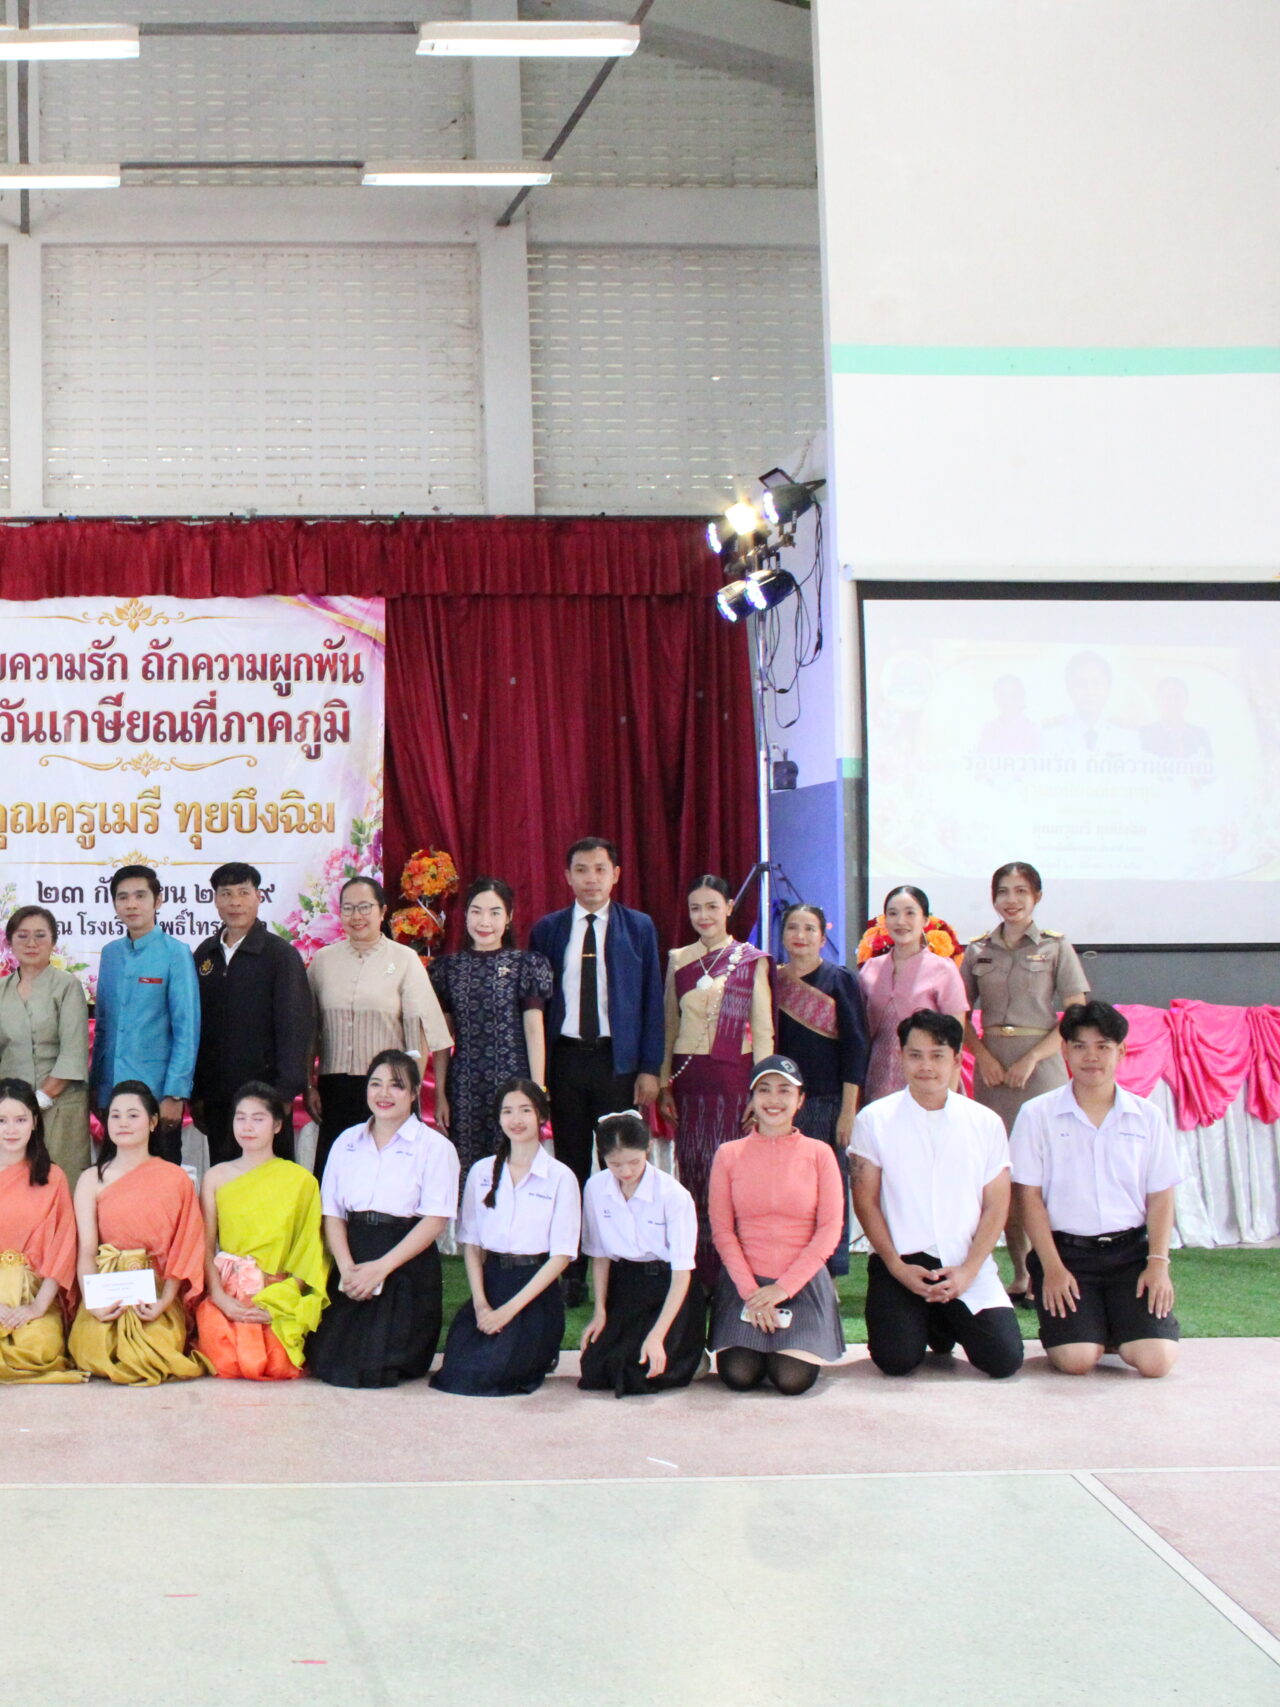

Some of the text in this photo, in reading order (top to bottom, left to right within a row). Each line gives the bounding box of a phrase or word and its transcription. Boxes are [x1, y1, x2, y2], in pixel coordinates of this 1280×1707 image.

[141, 634, 365, 698] ถักความผูกพัน
[173, 786, 336, 850] ทุยบึงฉิม
[36, 876, 276, 904] ๒๓ กัยน ๒๙
